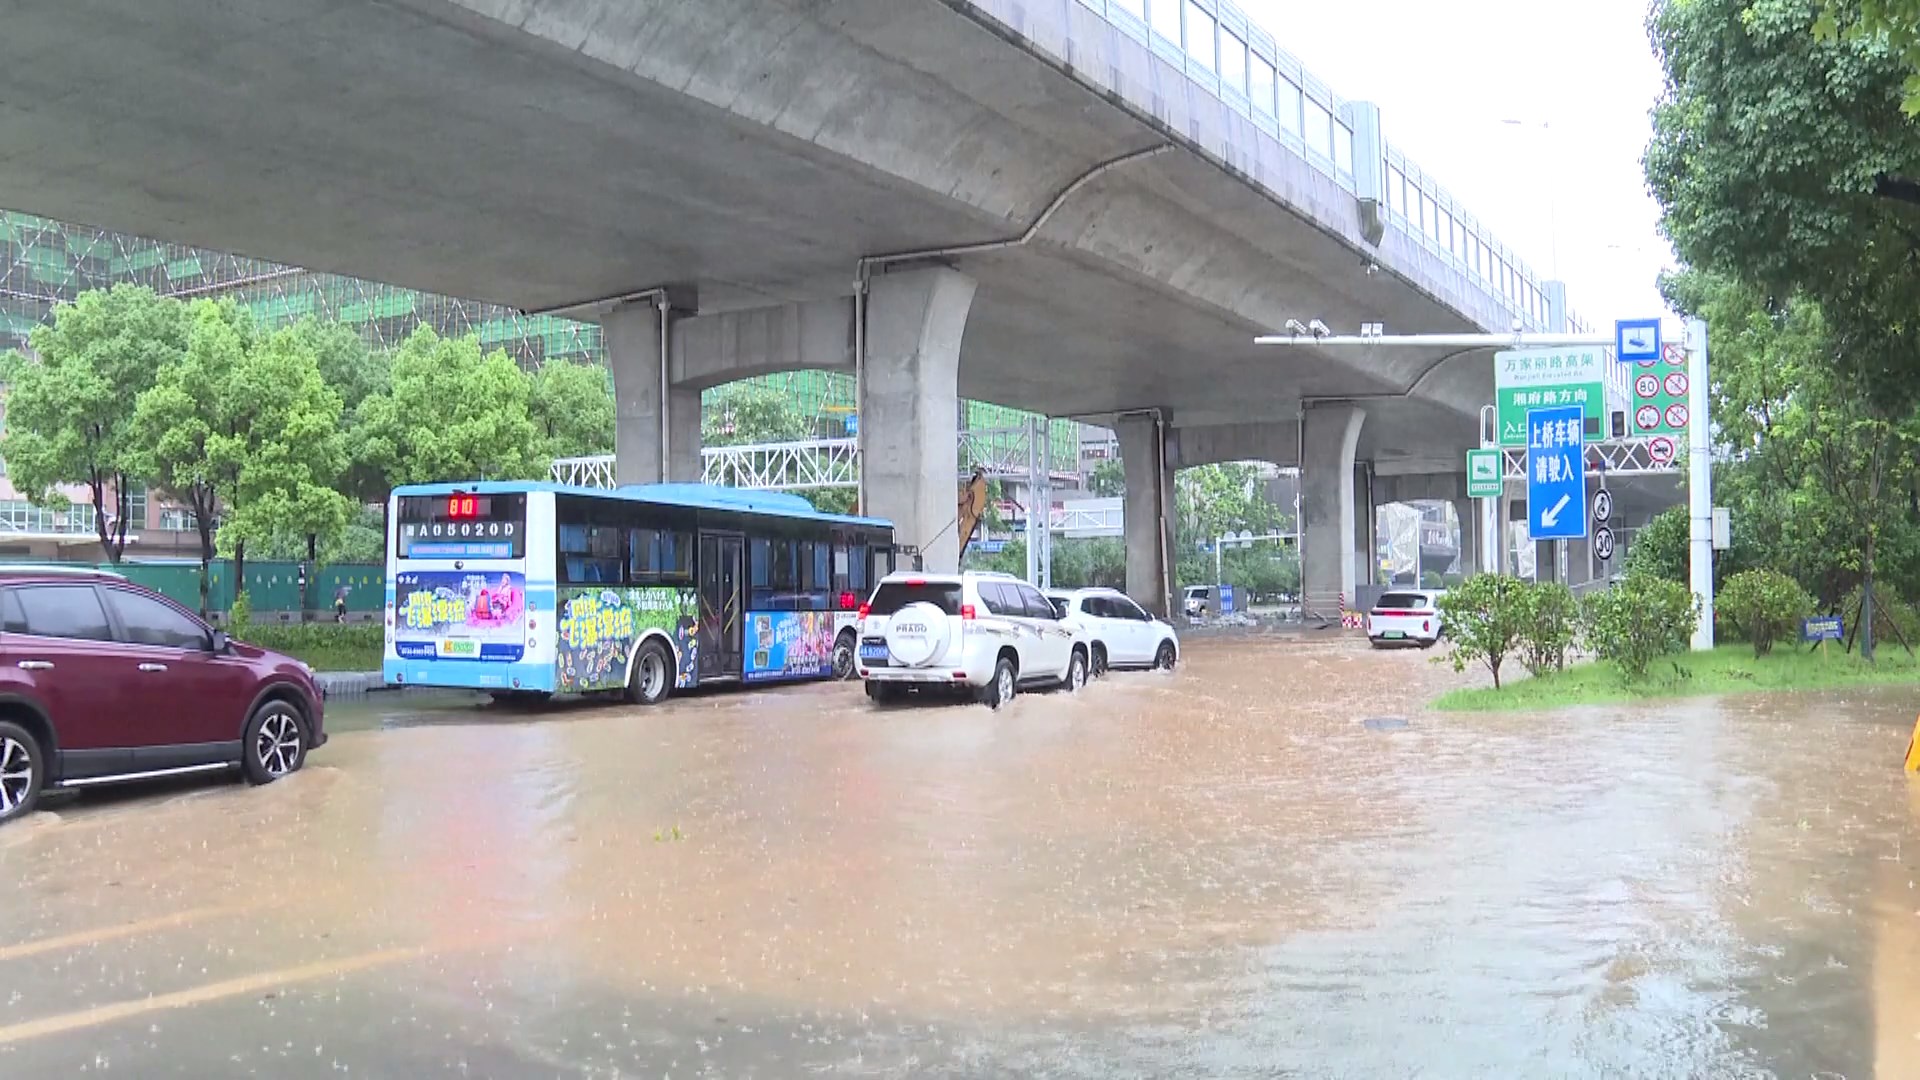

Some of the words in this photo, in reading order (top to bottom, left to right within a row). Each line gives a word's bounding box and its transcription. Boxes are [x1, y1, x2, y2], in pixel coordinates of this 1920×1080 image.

[1505, 353, 1594, 372] 万家丽路高架
[1639, 380, 1655, 393] 80
[1513, 388, 1588, 406] 湘府路方向
[1530, 417, 1580, 449] 上桥车辆
[1535, 454, 1575, 485] 请驶入
[449, 498, 473, 515] 810
[1598, 534, 1611, 552] 30
[896, 624, 927, 633] PRADO
